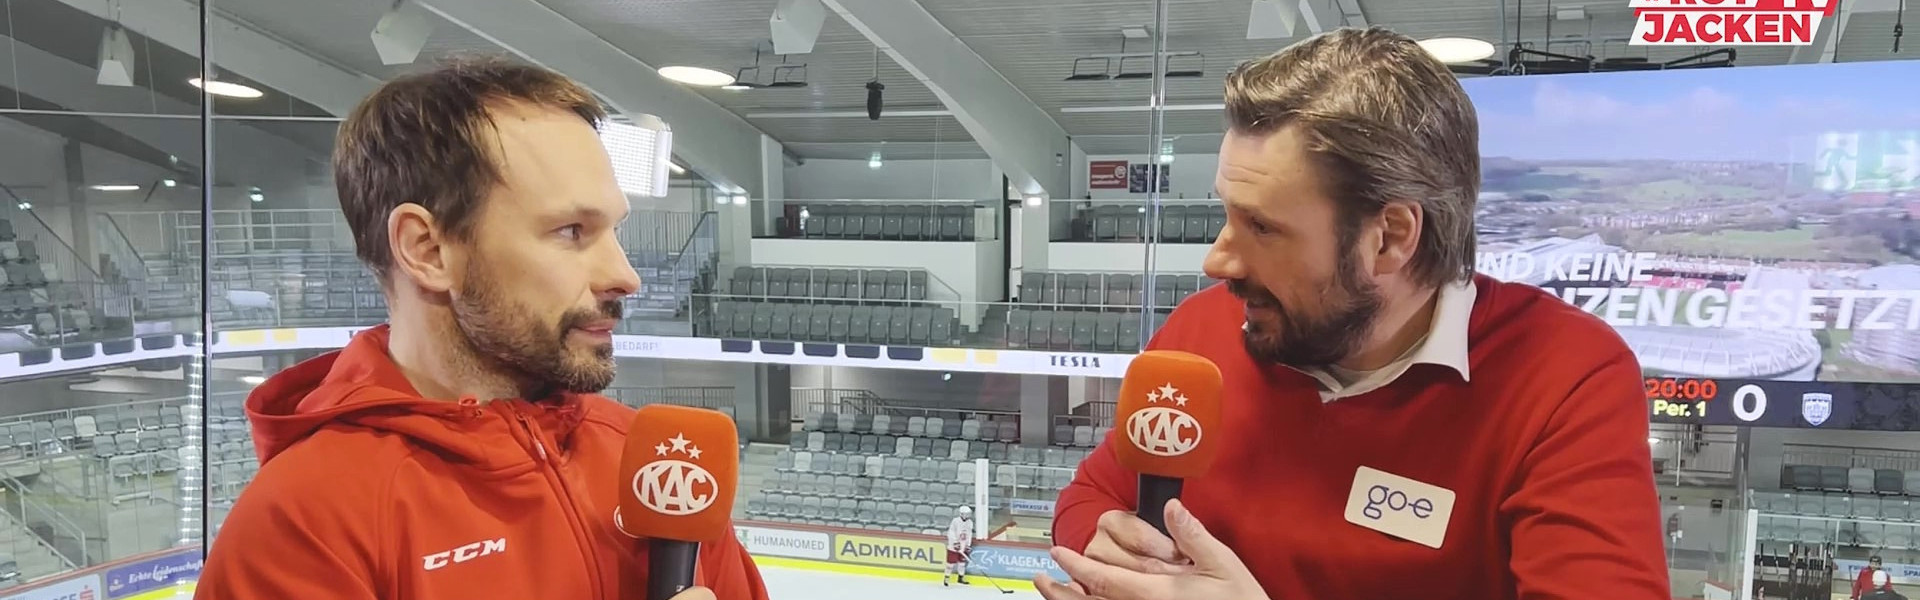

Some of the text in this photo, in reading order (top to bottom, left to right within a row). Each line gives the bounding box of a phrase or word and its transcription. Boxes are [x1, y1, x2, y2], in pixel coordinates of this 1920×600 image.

[1544, 252, 1656, 282] KEINE
[1050, 355, 1101, 368] TESLA
[1645, 379, 1717, 399] 20:00
[1653, 400, 1706, 417] Per. 1
[1733, 384, 1767, 422] 0
[1131, 410, 1194, 455] KAC
[639, 462, 708, 513] KAC
[423, 537, 506, 571] CCM
[753, 535, 825, 551] HUMANOMED
[840, 540, 943, 565] ADMIRAL
